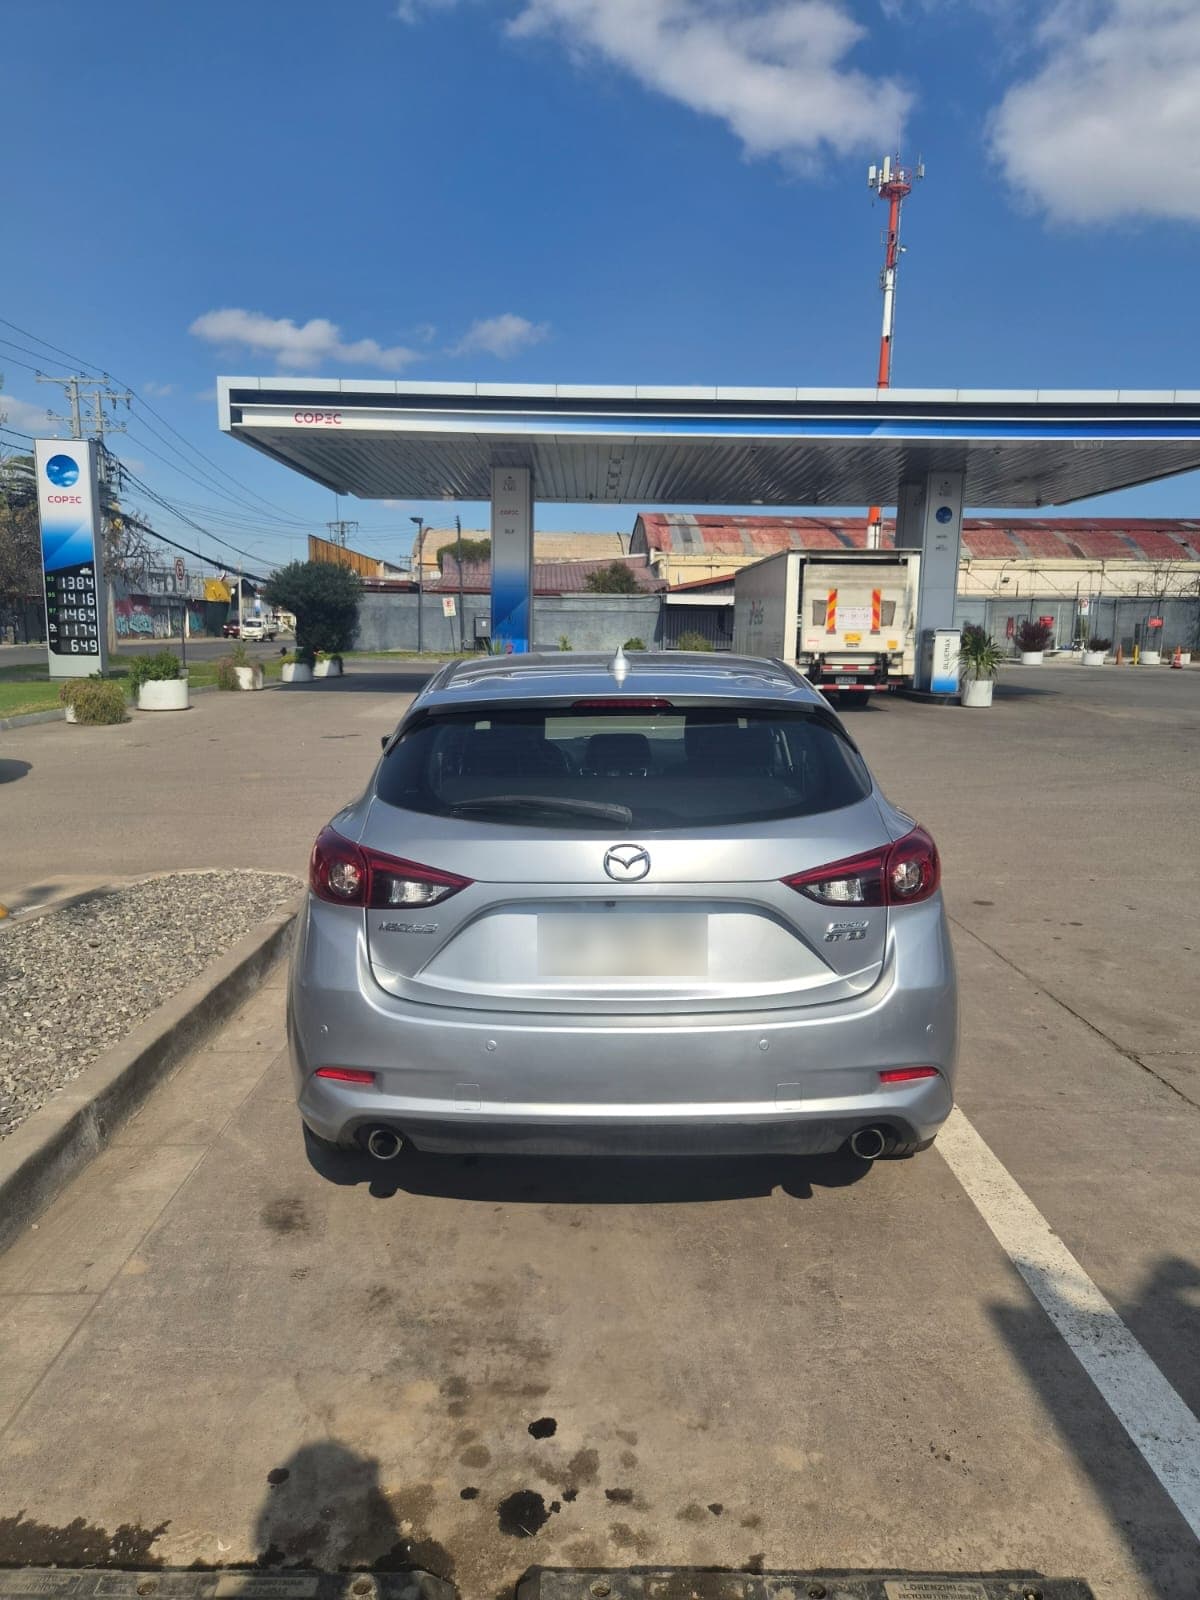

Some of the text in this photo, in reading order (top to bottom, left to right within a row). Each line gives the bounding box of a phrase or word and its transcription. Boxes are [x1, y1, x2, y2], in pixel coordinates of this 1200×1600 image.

[294, 412, 342, 425] COPEC
[47, 495, 82, 504] COPEC
[62, 576, 94, 590] 1384
[63, 592, 95, 606] 1416
[65, 623, 97, 637] 1174
[71, 639, 98, 653] 649
